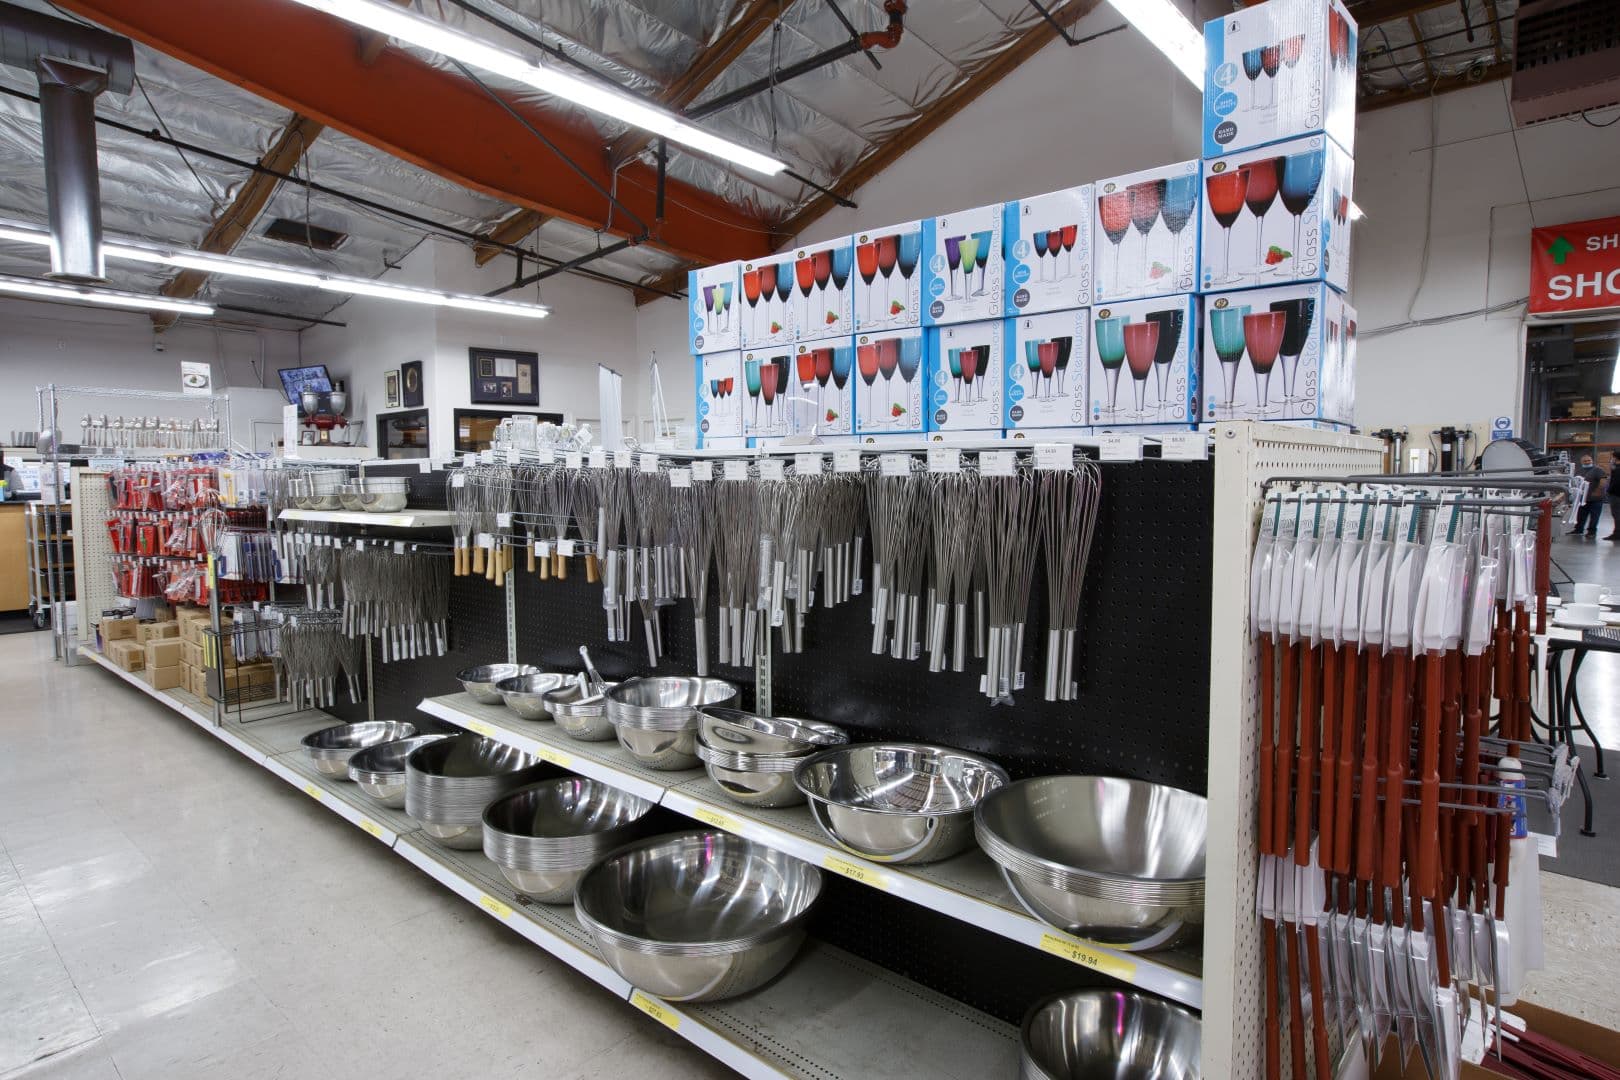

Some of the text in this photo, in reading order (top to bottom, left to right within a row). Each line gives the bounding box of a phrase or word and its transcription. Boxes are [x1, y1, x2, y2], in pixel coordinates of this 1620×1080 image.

[1301, 228, 1318, 277] Glass
[1586, 233, 1619, 251] SH
[1077, 262, 1090, 305] Glass
[1179, 246, 1193, 291] Glass
[909, 289, 920, 325] Glass
[989, 277, 1000, 316] Glass
[989, 389, 1000, 426] Glass
[1070, 383, 1083, 424] Glass
[1172, 376, 1186, 420] Glass
[1300, 370, 1317, 416] Glass
[1072, 950, 1098, 966] $19.94
